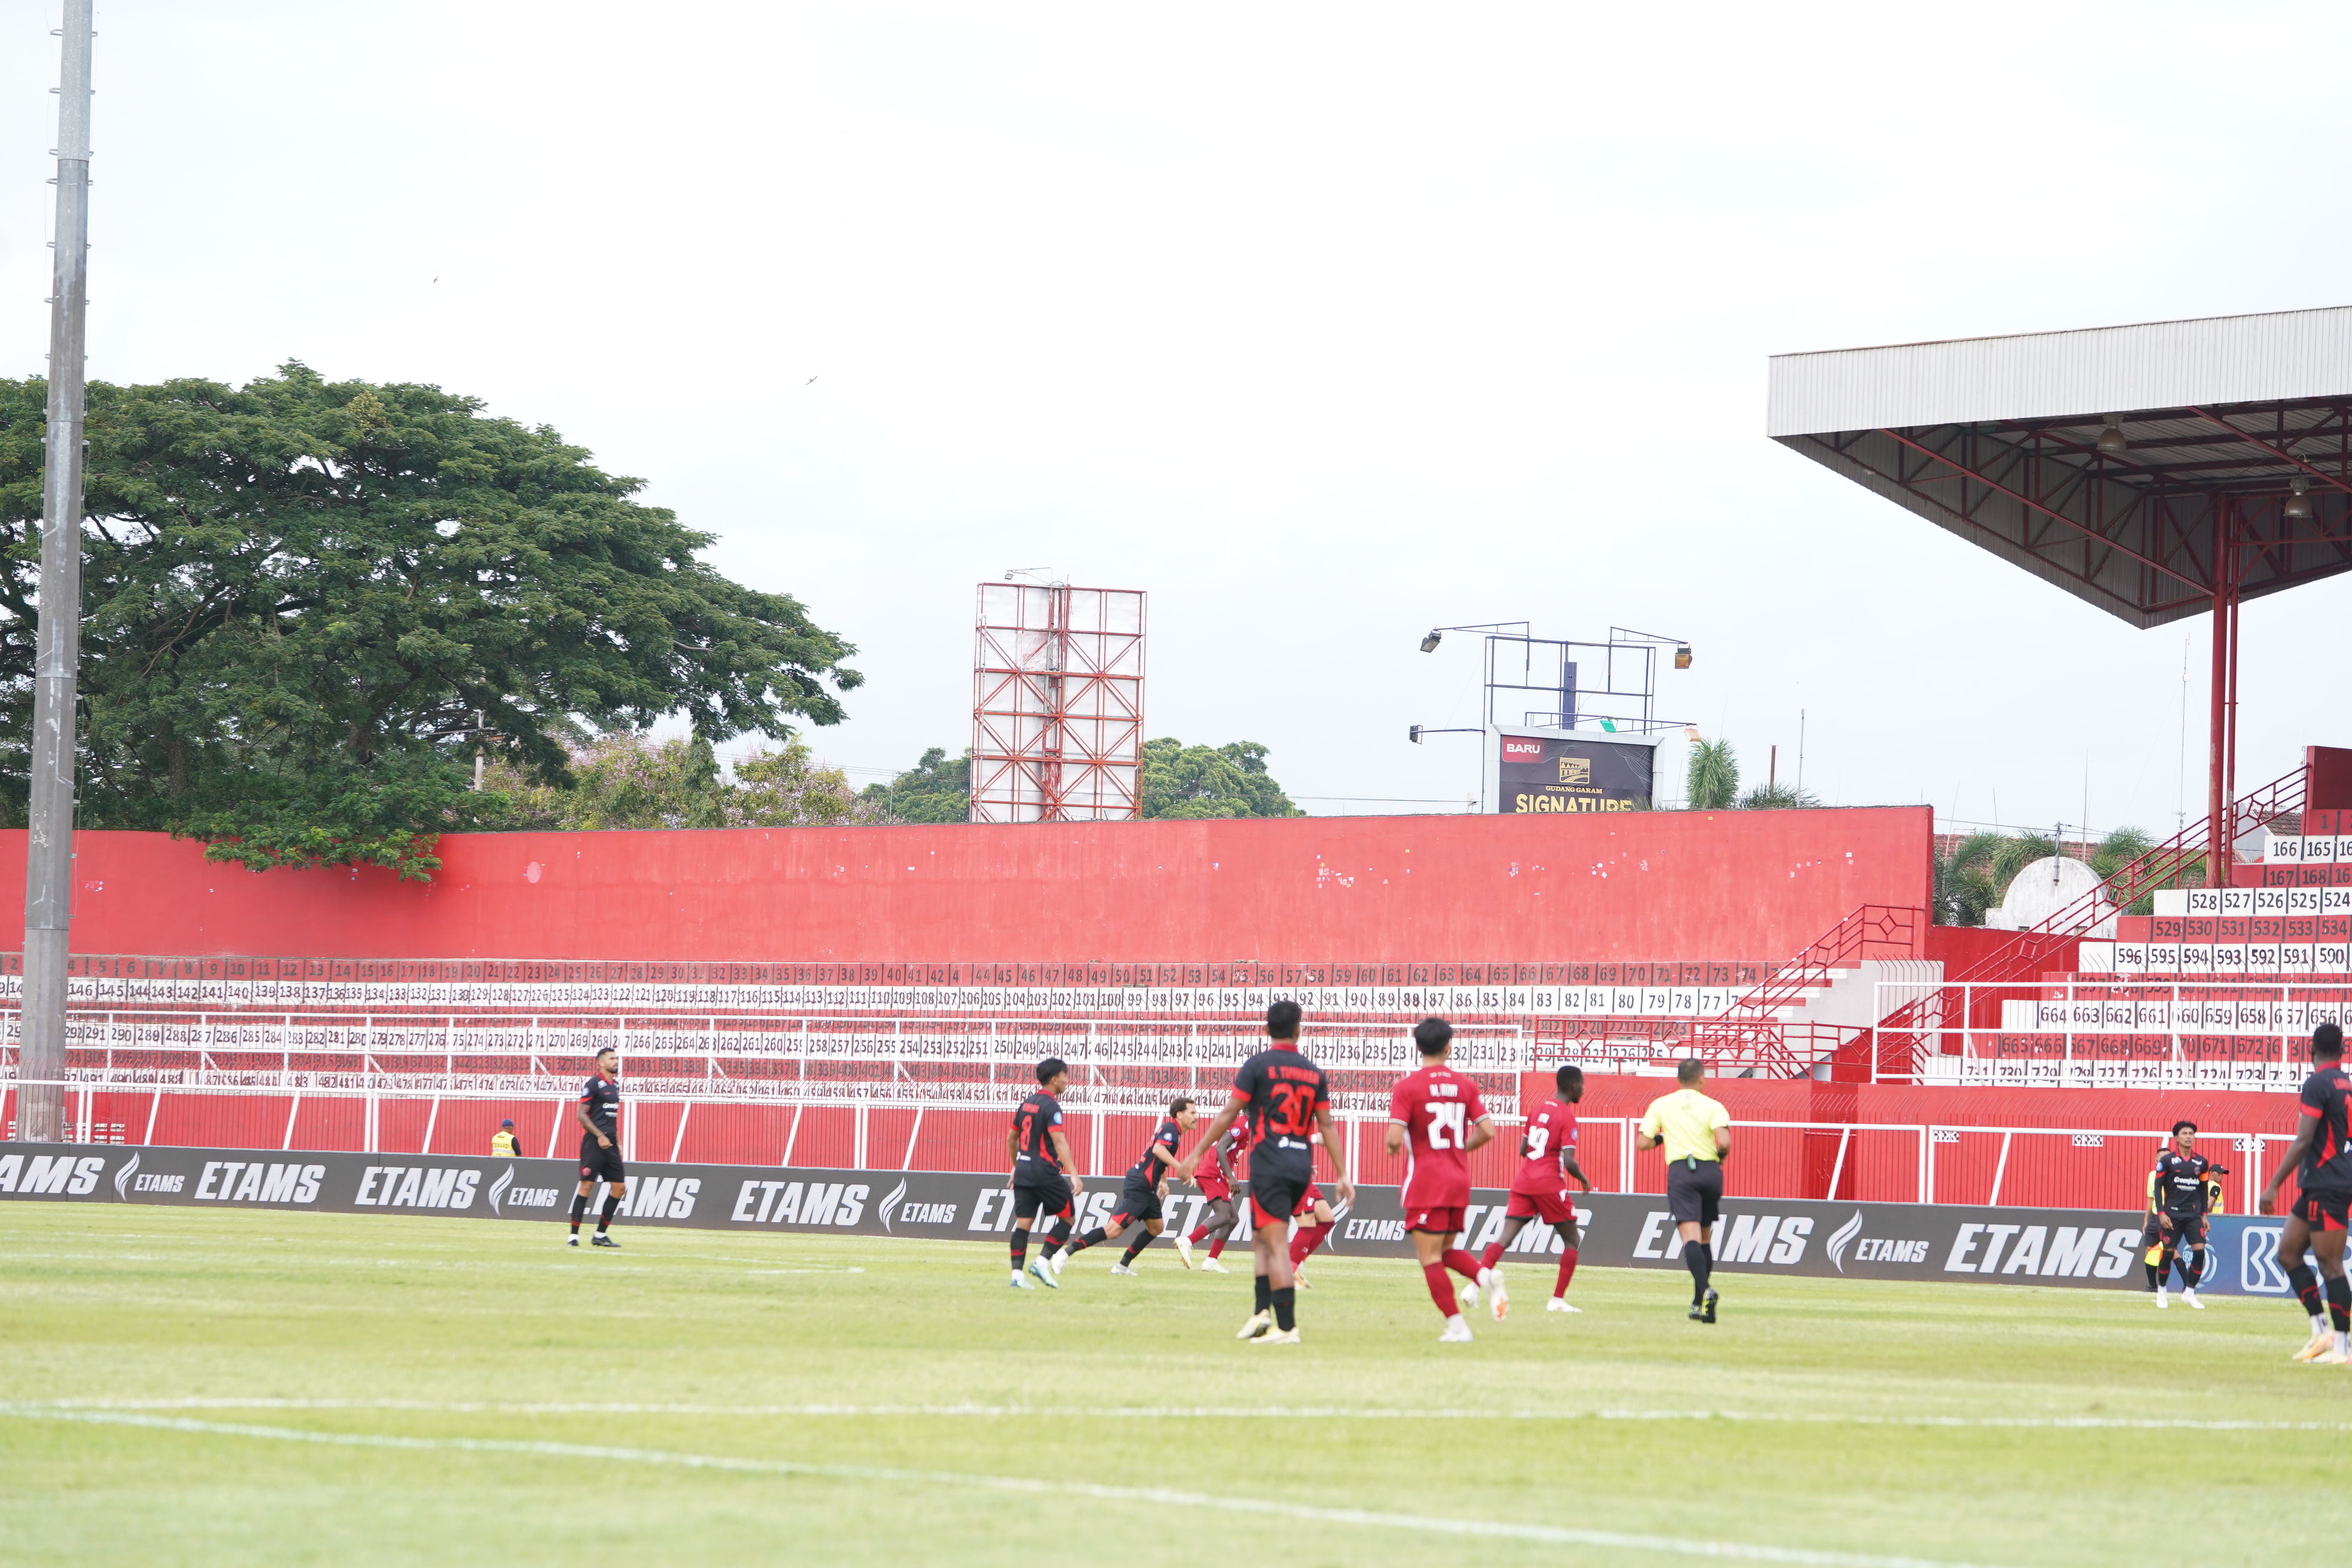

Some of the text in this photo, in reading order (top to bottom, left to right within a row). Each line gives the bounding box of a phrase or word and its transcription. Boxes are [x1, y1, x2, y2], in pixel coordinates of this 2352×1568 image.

[1507, 744, 1540, 754] BARU
[1515, 794, 1632, 813] SIGNATURE
[2273, 841, 2331, 856] 166 165
[2270, 870, 2327, 886] 167 168
[2192, 892, 2351, 909] 528 527 526 525 524
[2155, 920, 2348, 938] 529 530 531 532 533 534
[2118, 948, 2344, 965] 596 595 594 593 592 591 590
[10, 957, 1756, 984] 2 6 9 10 11 12 13 14 15 18 21 23 29 33 38 39 42 45 47 48 49 50 51 53 54 56 57 62 63 64 65 68 70 72 73 74
[68, 982, 1720, 1010] 146 143 139 138 128 121 117 107 106 99 98 97 96 95 94 92 91 90 89 86 84 83 82 81 80 79 78 77
[2041, 1007, 2337, 1025] 664 663 662 661 659 658 656
[111, 1027, 1494, 1060] 290 289 285 284 282 278 273 270 269 266 264 262 257 256 253 249 245 244 241 237 236 231
[2002, 1037, 2263, 1055] 665 666 668 669 671 672
[1269, 1083, 1316, 1136] 30
[1020, 1115, 1033, 1152] 8
[1425, 1102, 1466, 1150] 24
[1526, 1125, 1549, 1160] 9
[0, 1154, 105, 1195] AMS
[134, 1174, 185, 1193] ETAMS
[194, 1161, 326, 1203] ETAMS
[354, 1166, 482, 1209] ETAMS
[508, 1186, 559, 1207] ETAMS
[731, 1180, 870, 1226] ETAMS
[901, 1202, 957, 1224] ETAMS
[1345, 1219, 1405, 1241] ETAMS
[1855, 1238, 1930, 1263] ETAMS
[1944, 1223, 2143, 1279] ETAMS
